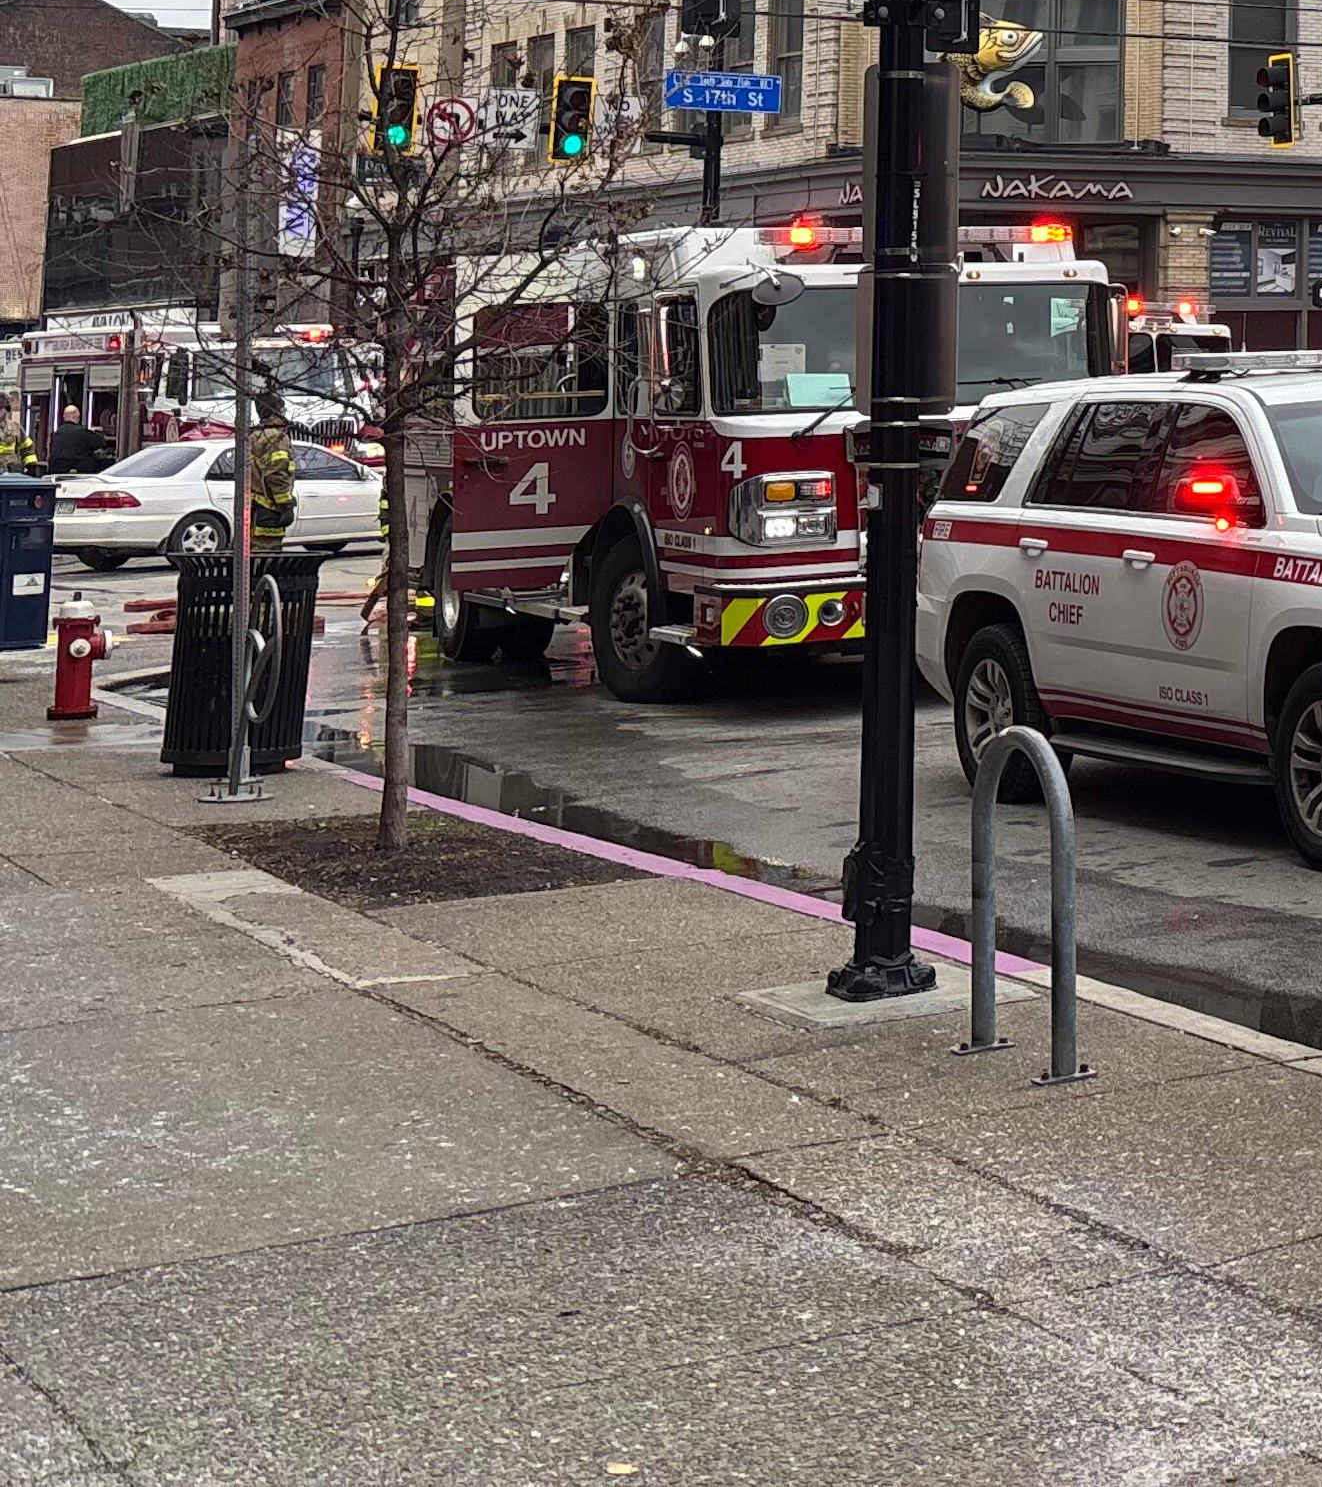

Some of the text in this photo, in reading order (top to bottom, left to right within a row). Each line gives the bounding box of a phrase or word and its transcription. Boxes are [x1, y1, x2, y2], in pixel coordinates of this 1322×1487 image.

[500, 95, 531, 109] ONE
[683, 88, 764, 107] S 17th St
[981, 173, 1134, 201] NAKAMA
[480, 427, 587, 451] UPTOWN
[720, 441, 748, 479] 4
[509, 462, 557, 515] 4
[675, 533, 692, 549] CLASS
[1035, 569, 1101, 596] BATTALION
[1049, 601, 1084, 625] CHIEF
[1158, 685, 1210, 707] ISO CLASS 1
